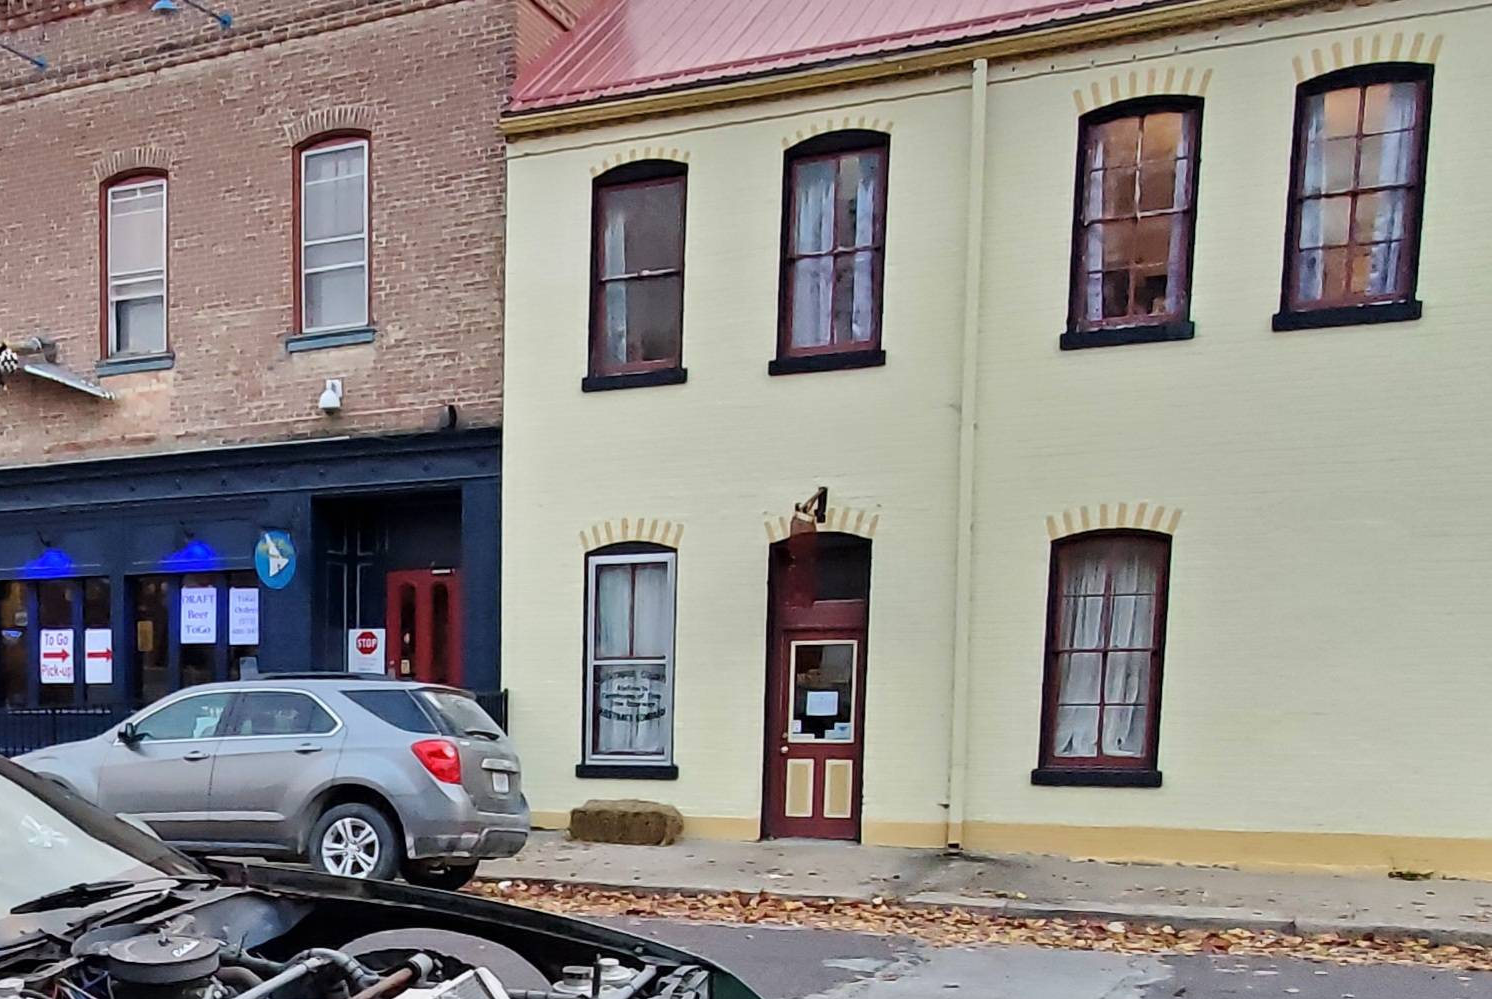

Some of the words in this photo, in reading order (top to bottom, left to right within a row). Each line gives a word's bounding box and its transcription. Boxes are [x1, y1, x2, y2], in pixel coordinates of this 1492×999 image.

[182, 594, 214, 604] DRAFT
[188, 608, 208, 619] Beer
[44, 633, 54, 646] To
[56, 632, 68, 646] Go
[358, 638, 377, 648] STOP
[41, 664, 72, 678] Pick-up
